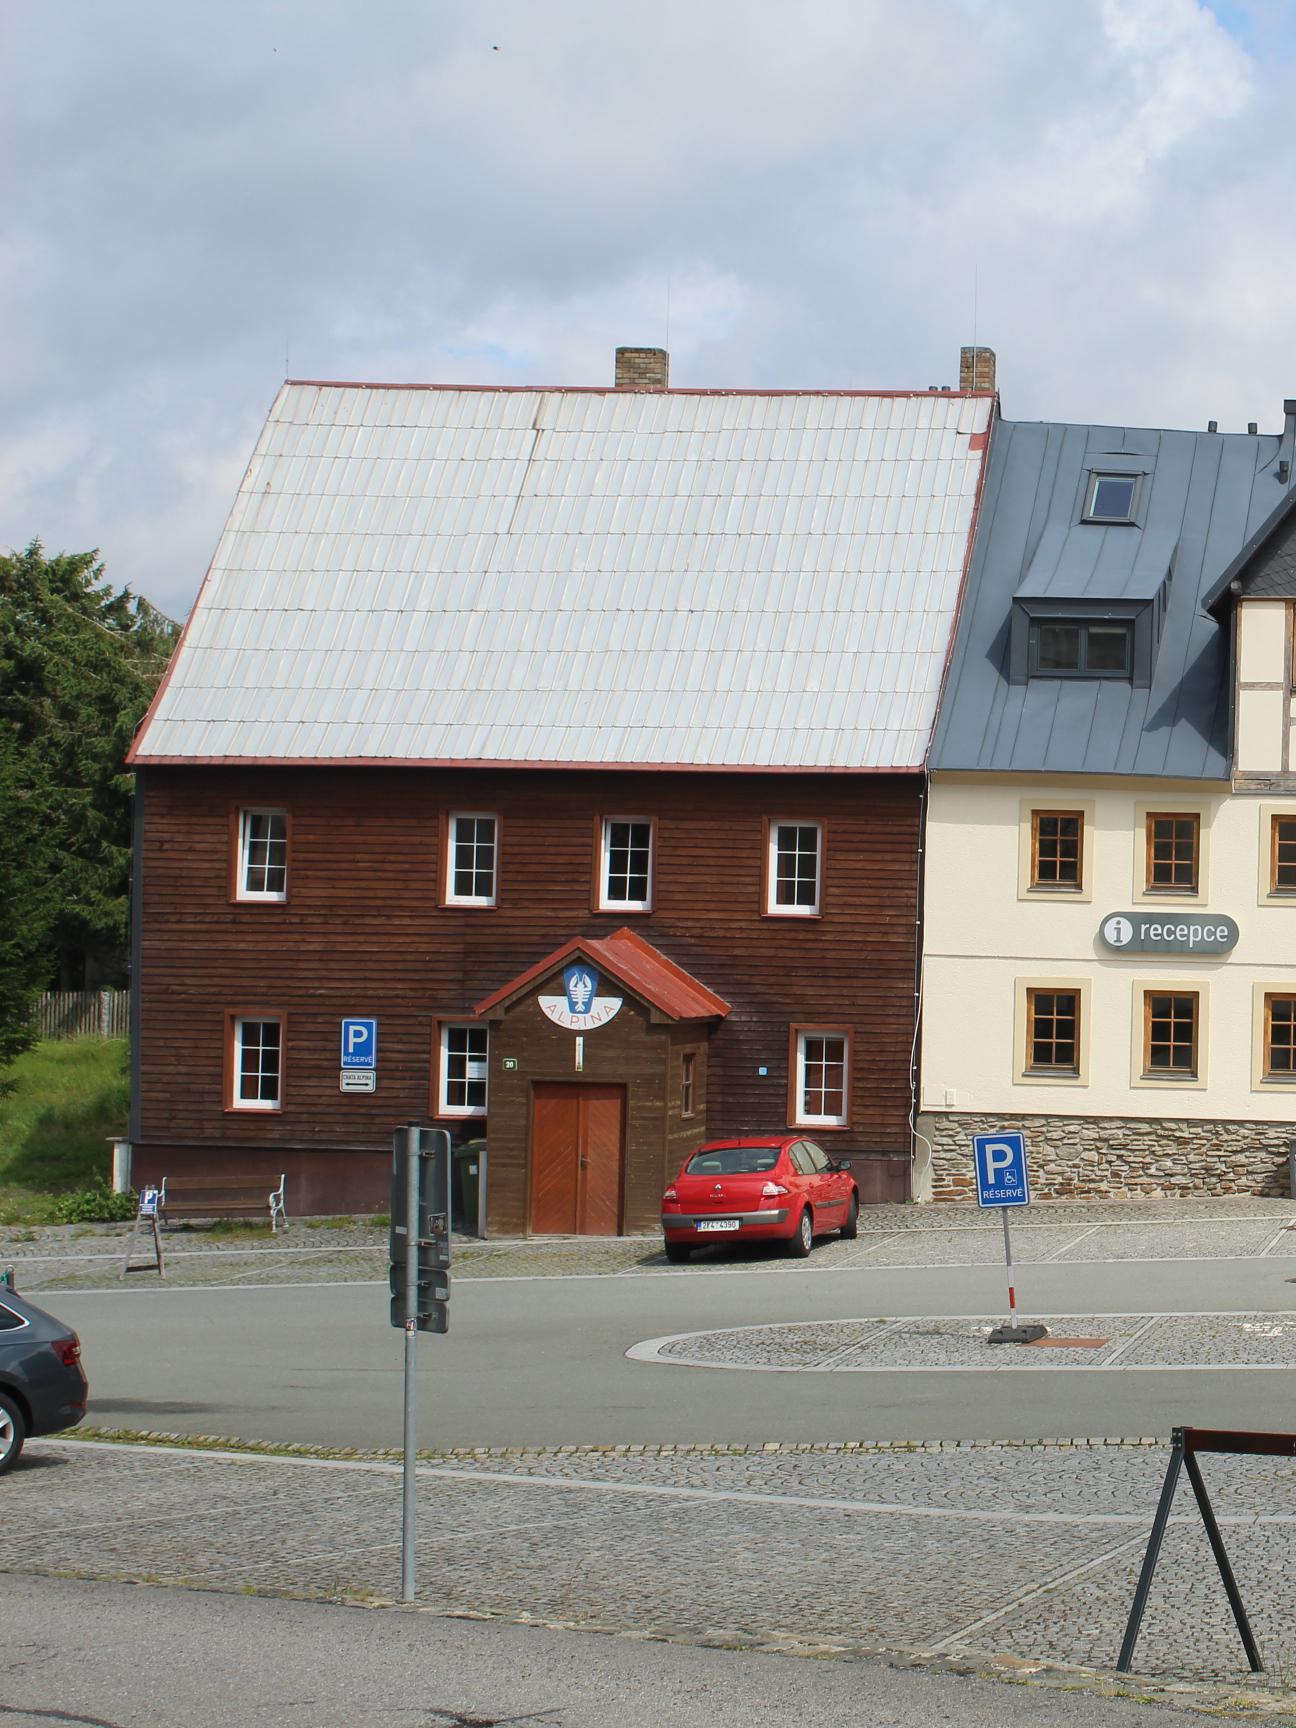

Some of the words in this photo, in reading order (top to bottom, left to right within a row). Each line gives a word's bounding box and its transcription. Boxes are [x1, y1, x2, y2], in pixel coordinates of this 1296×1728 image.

[1140, 923, 1229, 948] recepce
[545, 1004, 616, 1027] ALPINA
[348, 1025, 369, 1053] P
[985, 1143, 1014, 1185] P
[144, 1192, 153, 1204] P
[983, 1187, 1023, 1199] RÉSERVÉ
